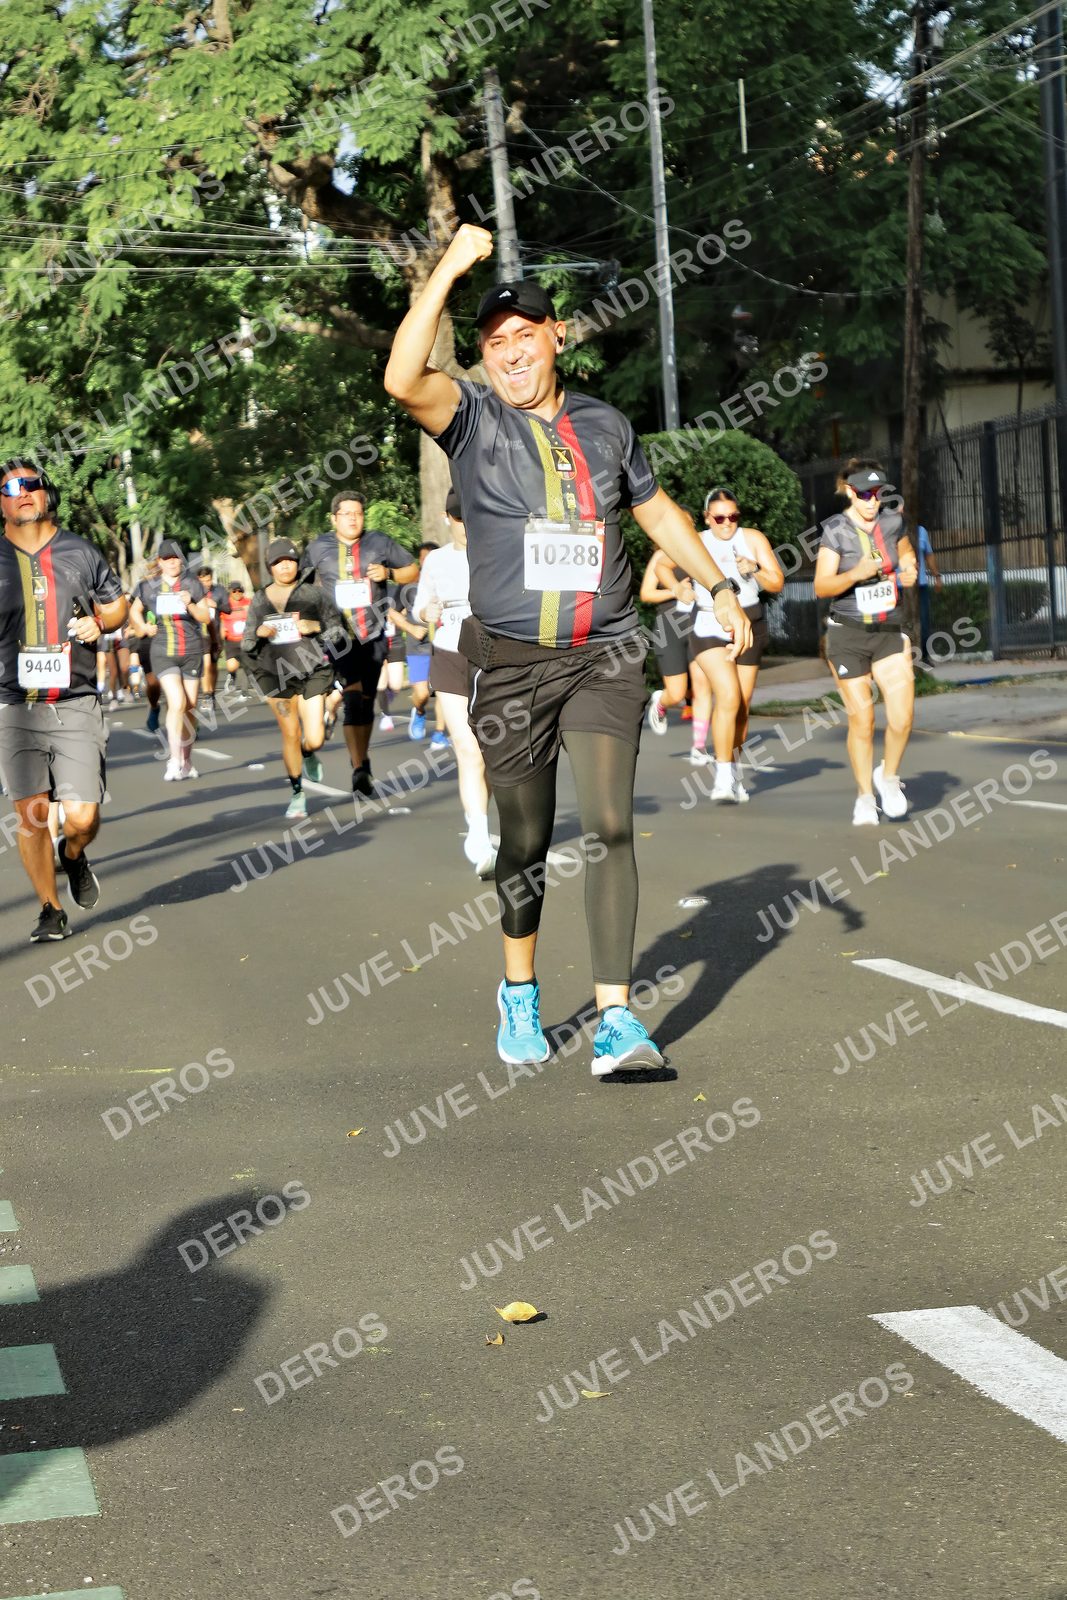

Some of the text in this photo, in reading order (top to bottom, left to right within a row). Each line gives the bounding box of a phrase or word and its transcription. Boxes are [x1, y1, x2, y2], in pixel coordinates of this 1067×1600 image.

[530, 544, 599, 567] 10288
[862, 585, 892, 602] 11438
[25, 659, 61, 673] 9440
